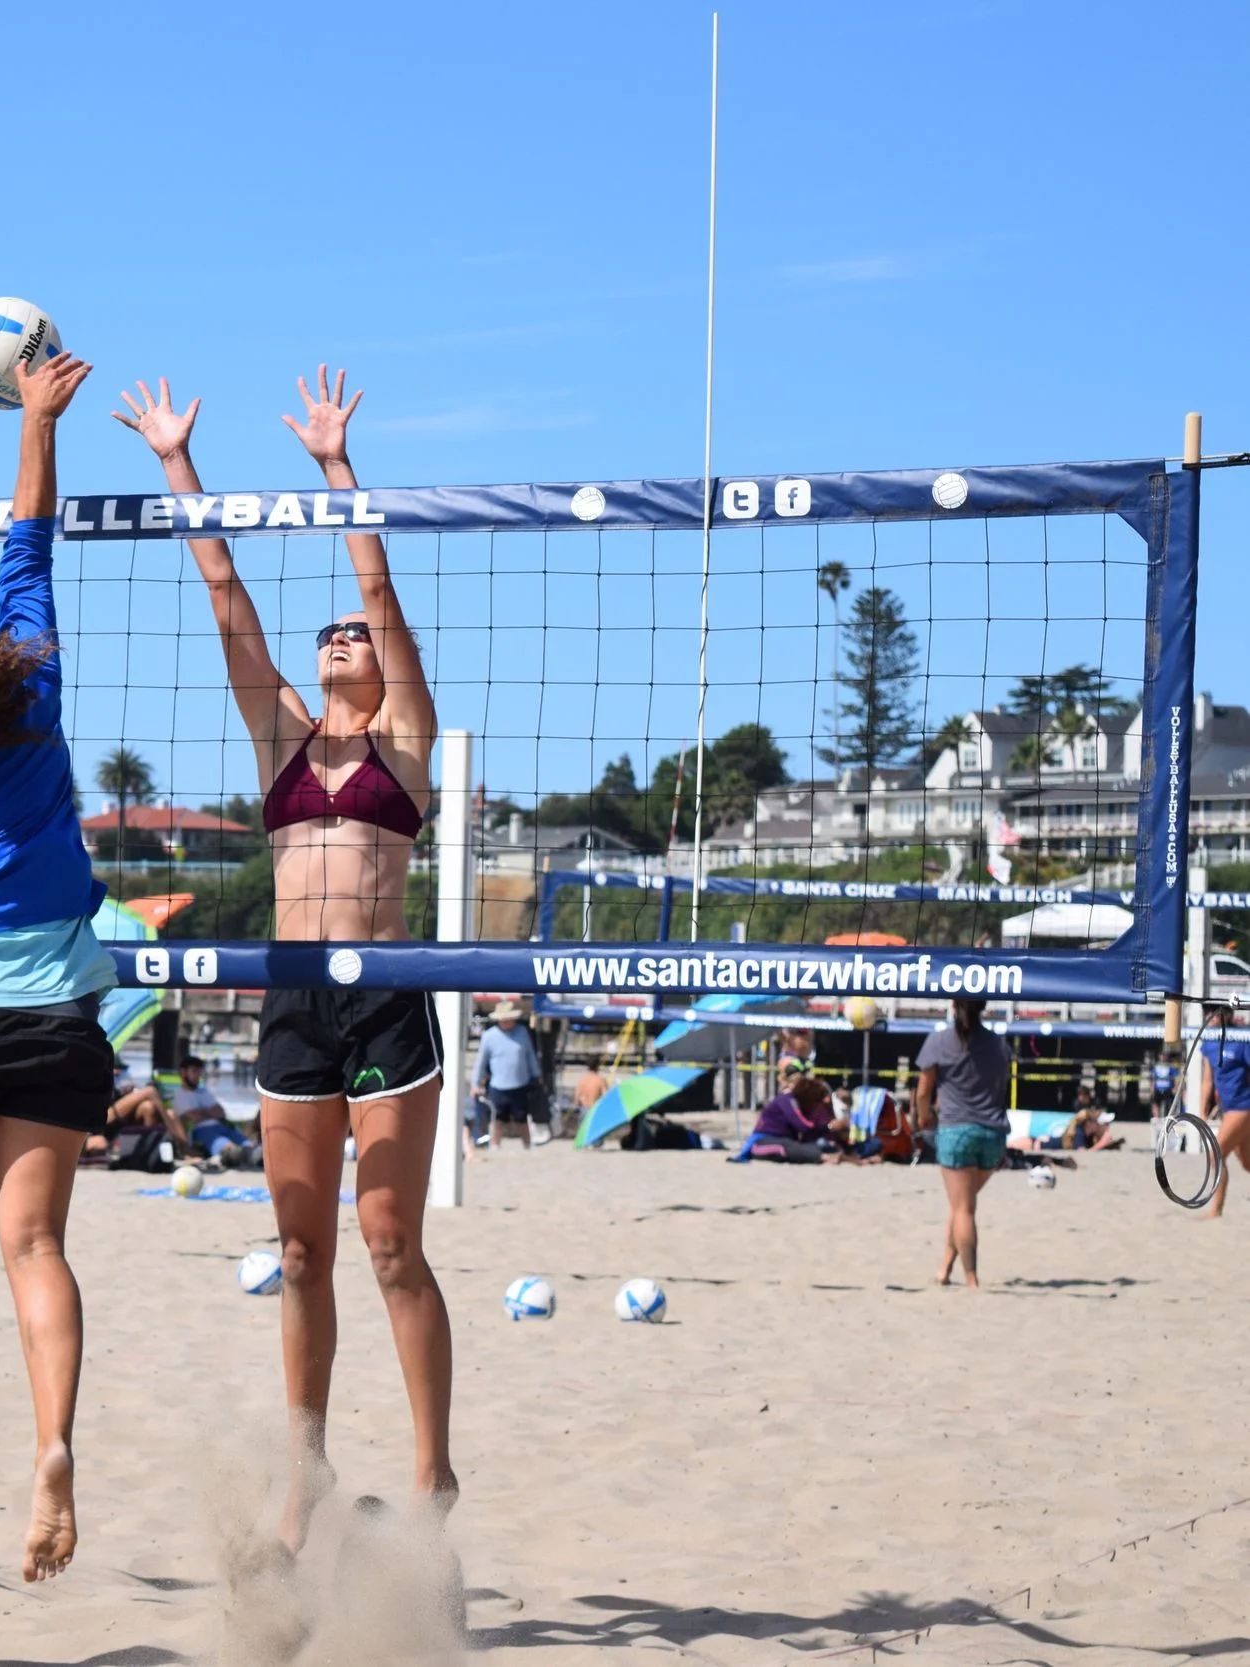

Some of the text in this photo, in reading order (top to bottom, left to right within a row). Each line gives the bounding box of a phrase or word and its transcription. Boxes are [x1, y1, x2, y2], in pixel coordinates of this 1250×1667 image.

[18, 318, 47, 363] Wilson
[781, 881, 842, 896] SANTA
[845, 883, 897, 898] CRUZ
[532, 951, 1023, 994] www.santacruzwharf.com
